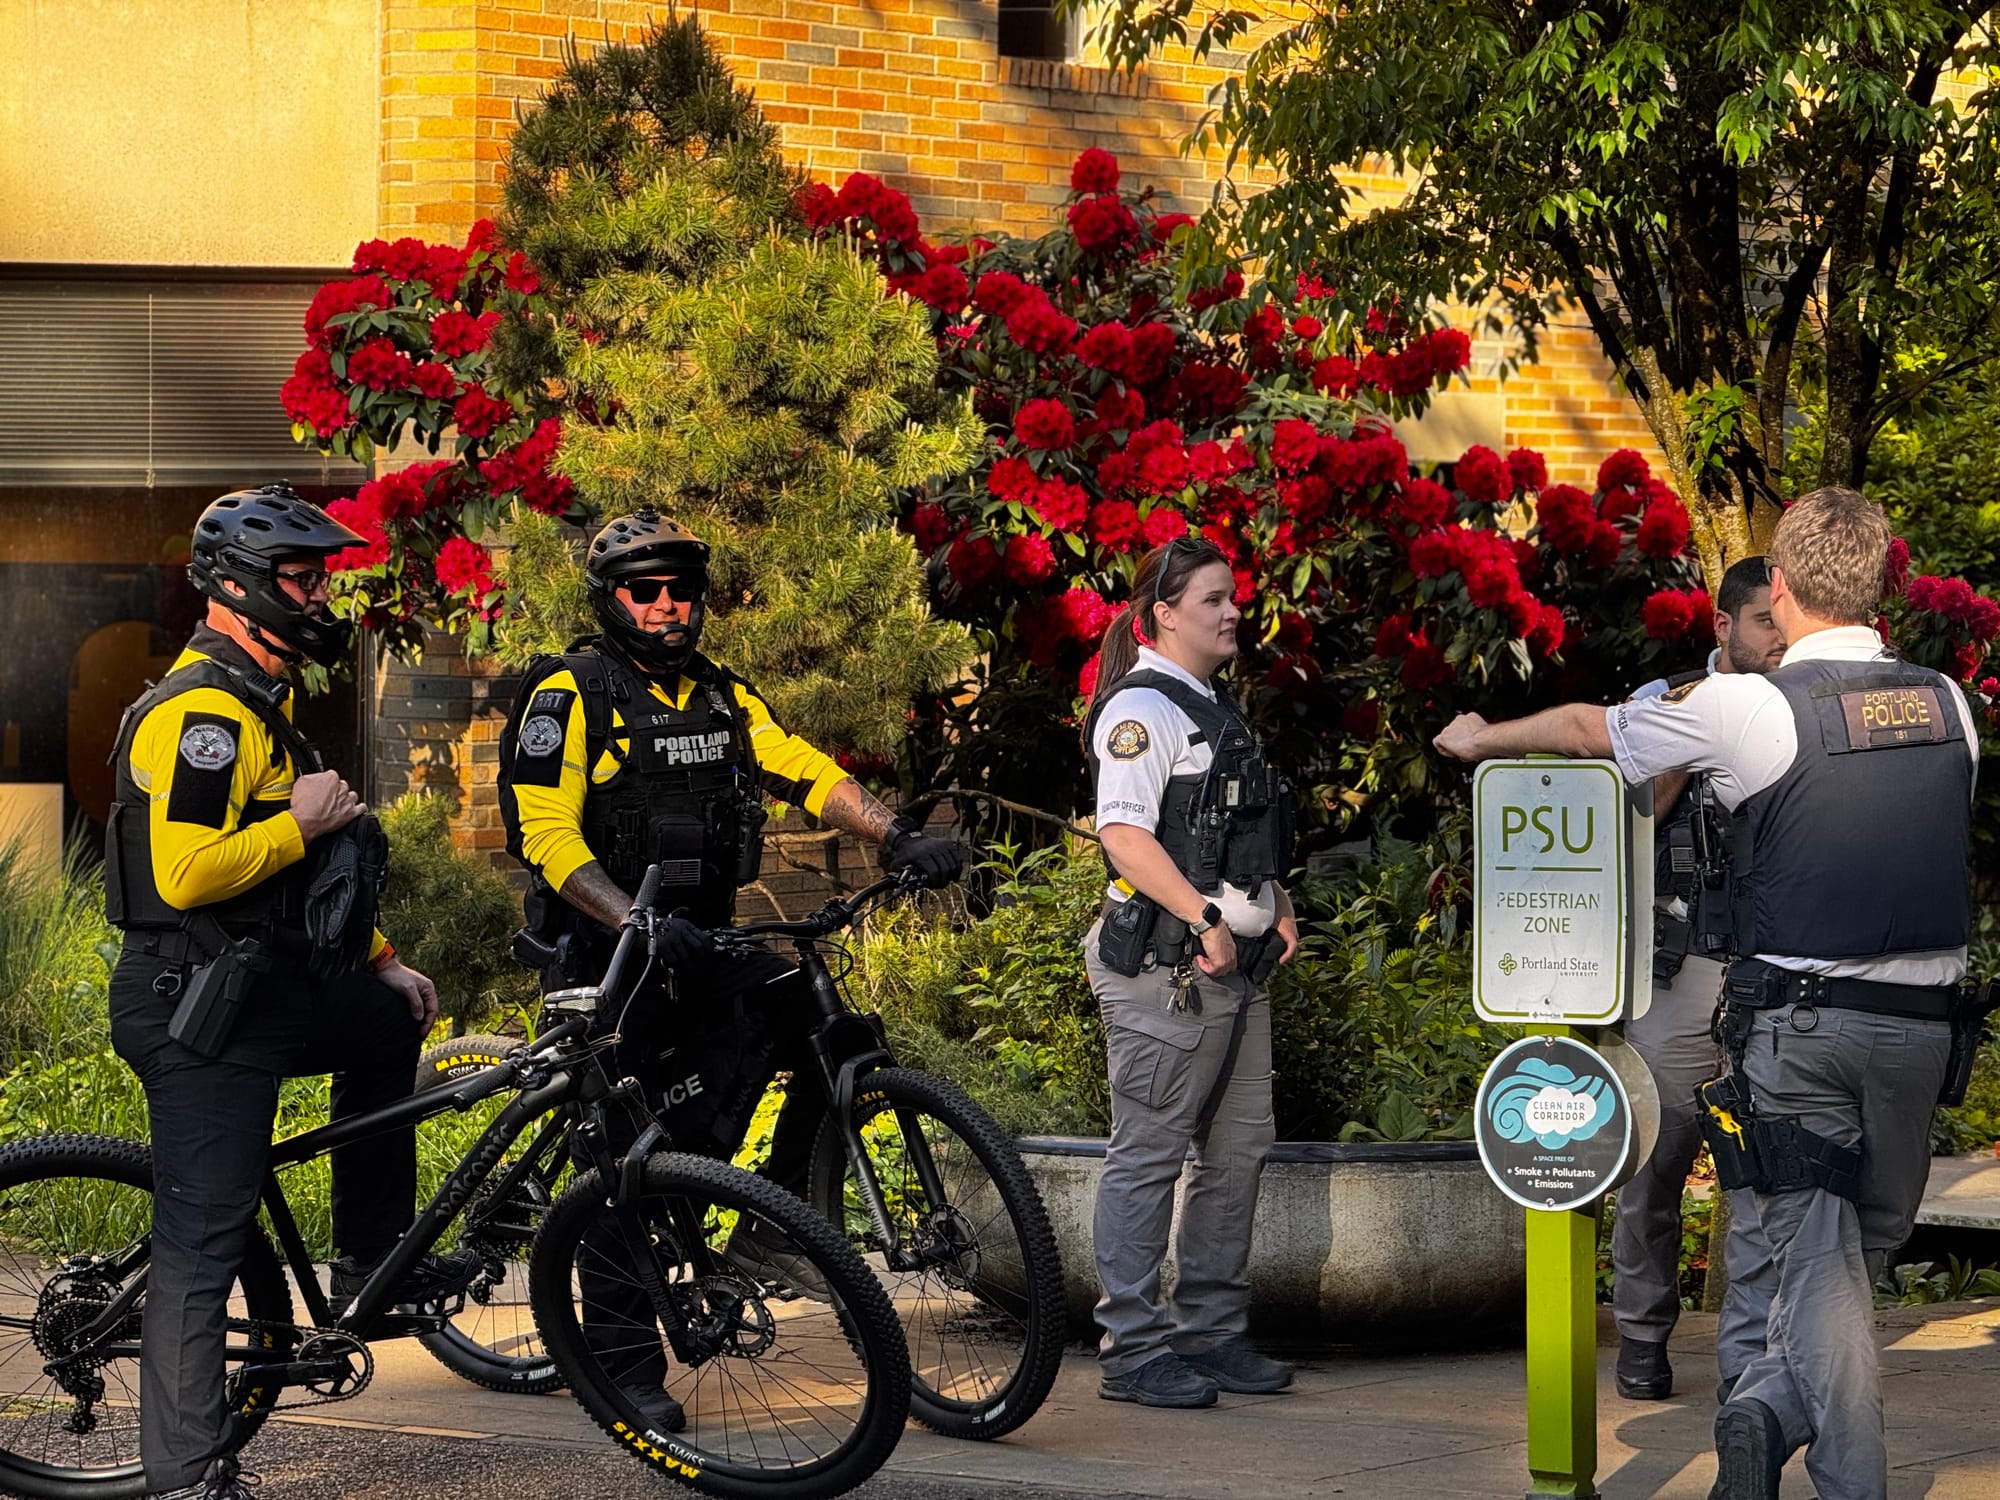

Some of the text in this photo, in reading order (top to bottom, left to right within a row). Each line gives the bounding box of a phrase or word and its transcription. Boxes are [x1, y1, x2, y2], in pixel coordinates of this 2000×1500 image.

[1865, 691, 1919, 705] PORTLAND
[651, 714, 670, 725] 617
[1862, 702, 1931, 728] POLICE
[654, 730, 731, 752] PORTLAND
[667, 745, 725, 765] POLICE
[1502, 806, 1594, 854] PSU
[1497, 892, 1600, 909] PEDESTRIAN
[1524, 917, 1571, 933] ZONE
[1521, 956, 1600, 971] Portland State
[435, 1054, 501, 1072] MAXXIS
[1533, 1101, 1586, 1111] CLEAN AIR
[1533, 1111, 1586, 1121] CORRIDOR
[1514, 1166, 1596, 1178] Smoke Pollutants
[1534, 1179, 1574, 1189] Emissions
[613, 1421, 700, 1479] MAXXIS
[668, 1443, 706, 1468] SWISS
